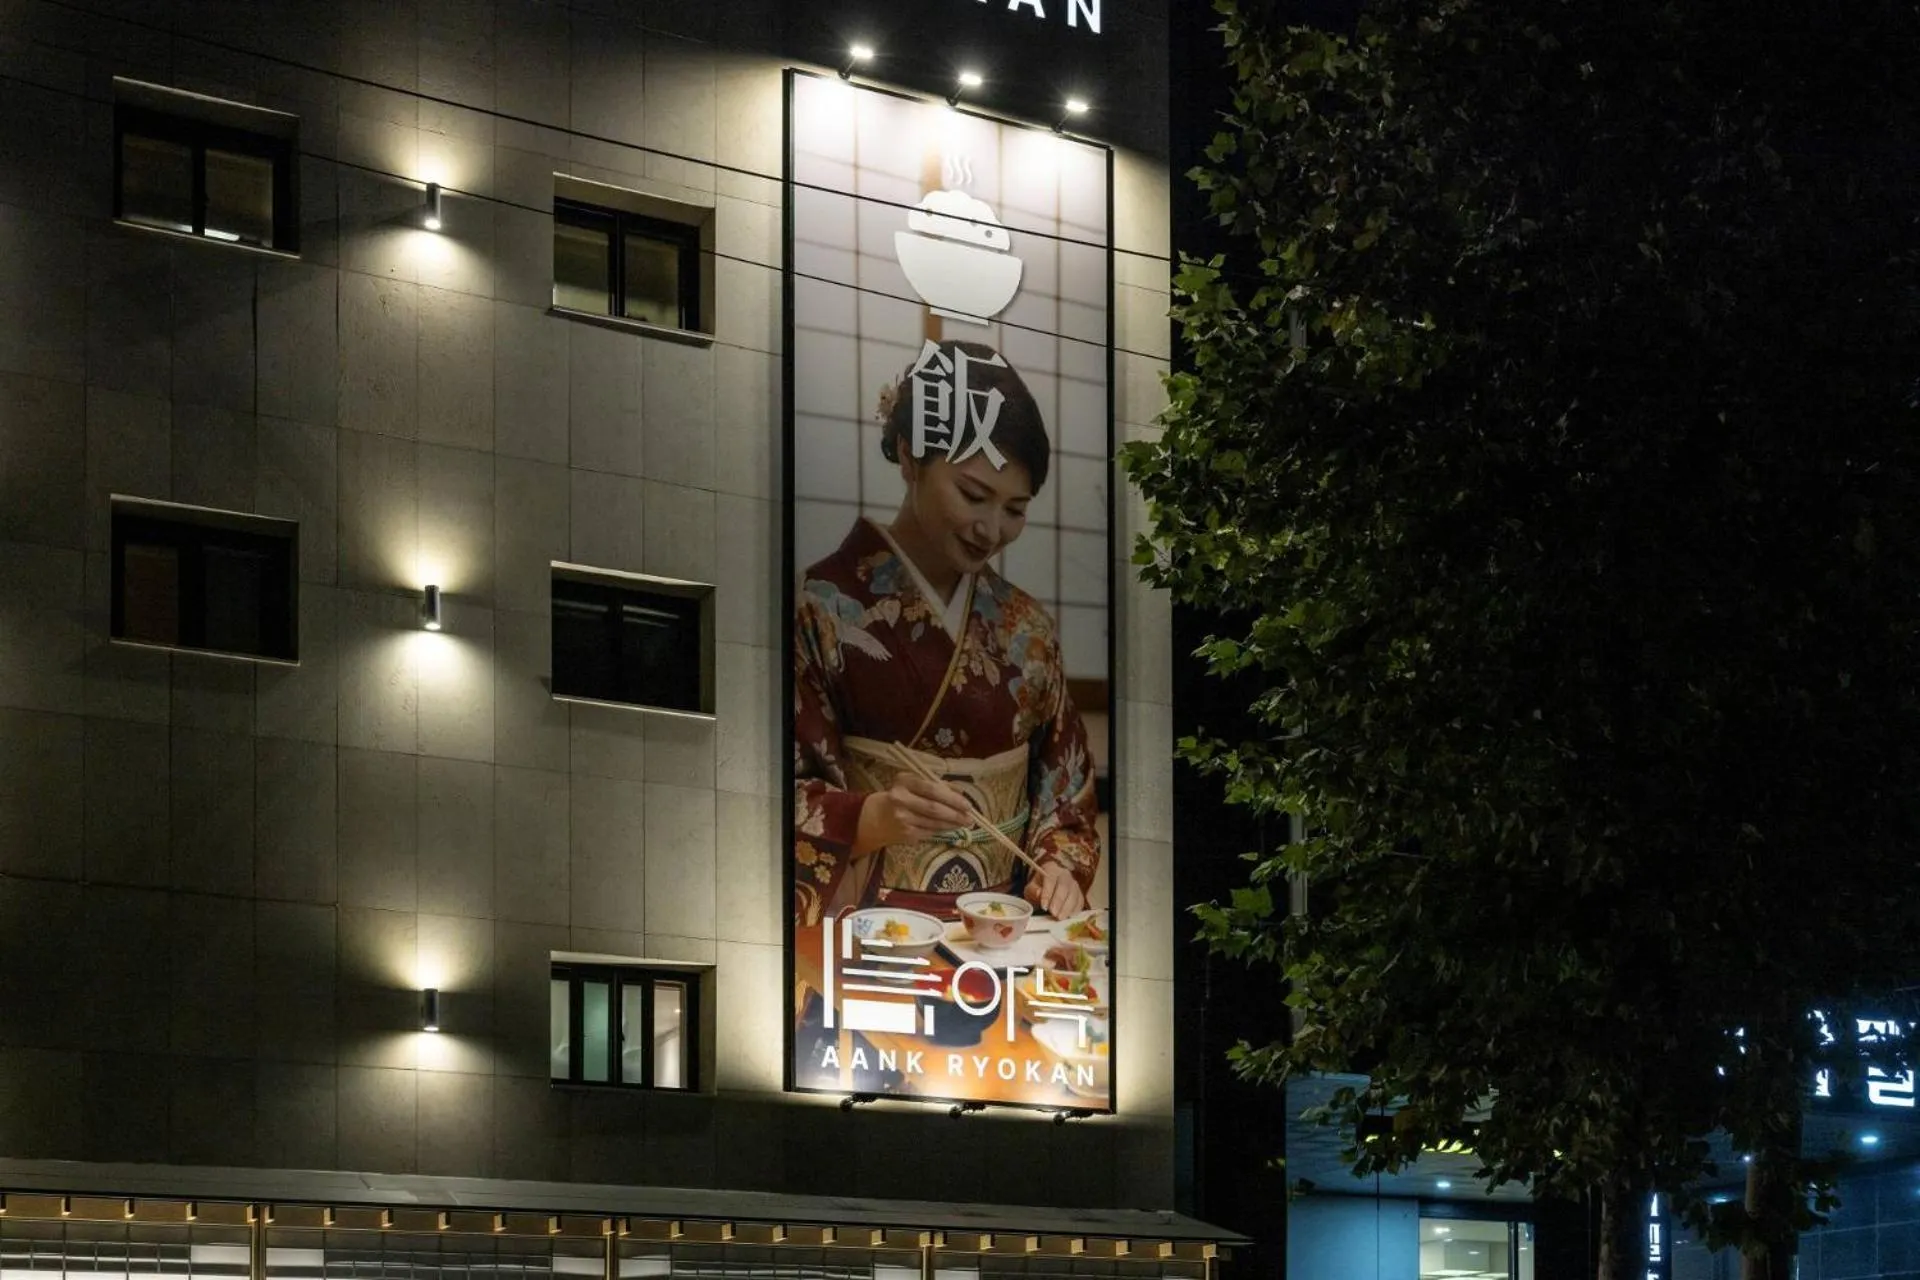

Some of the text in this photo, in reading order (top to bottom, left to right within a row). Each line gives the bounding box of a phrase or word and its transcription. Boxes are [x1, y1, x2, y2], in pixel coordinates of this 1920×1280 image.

[907, 338, 1009, 471] 飯
[821, 1046, 1095, 1087] AANK RYOKAN
